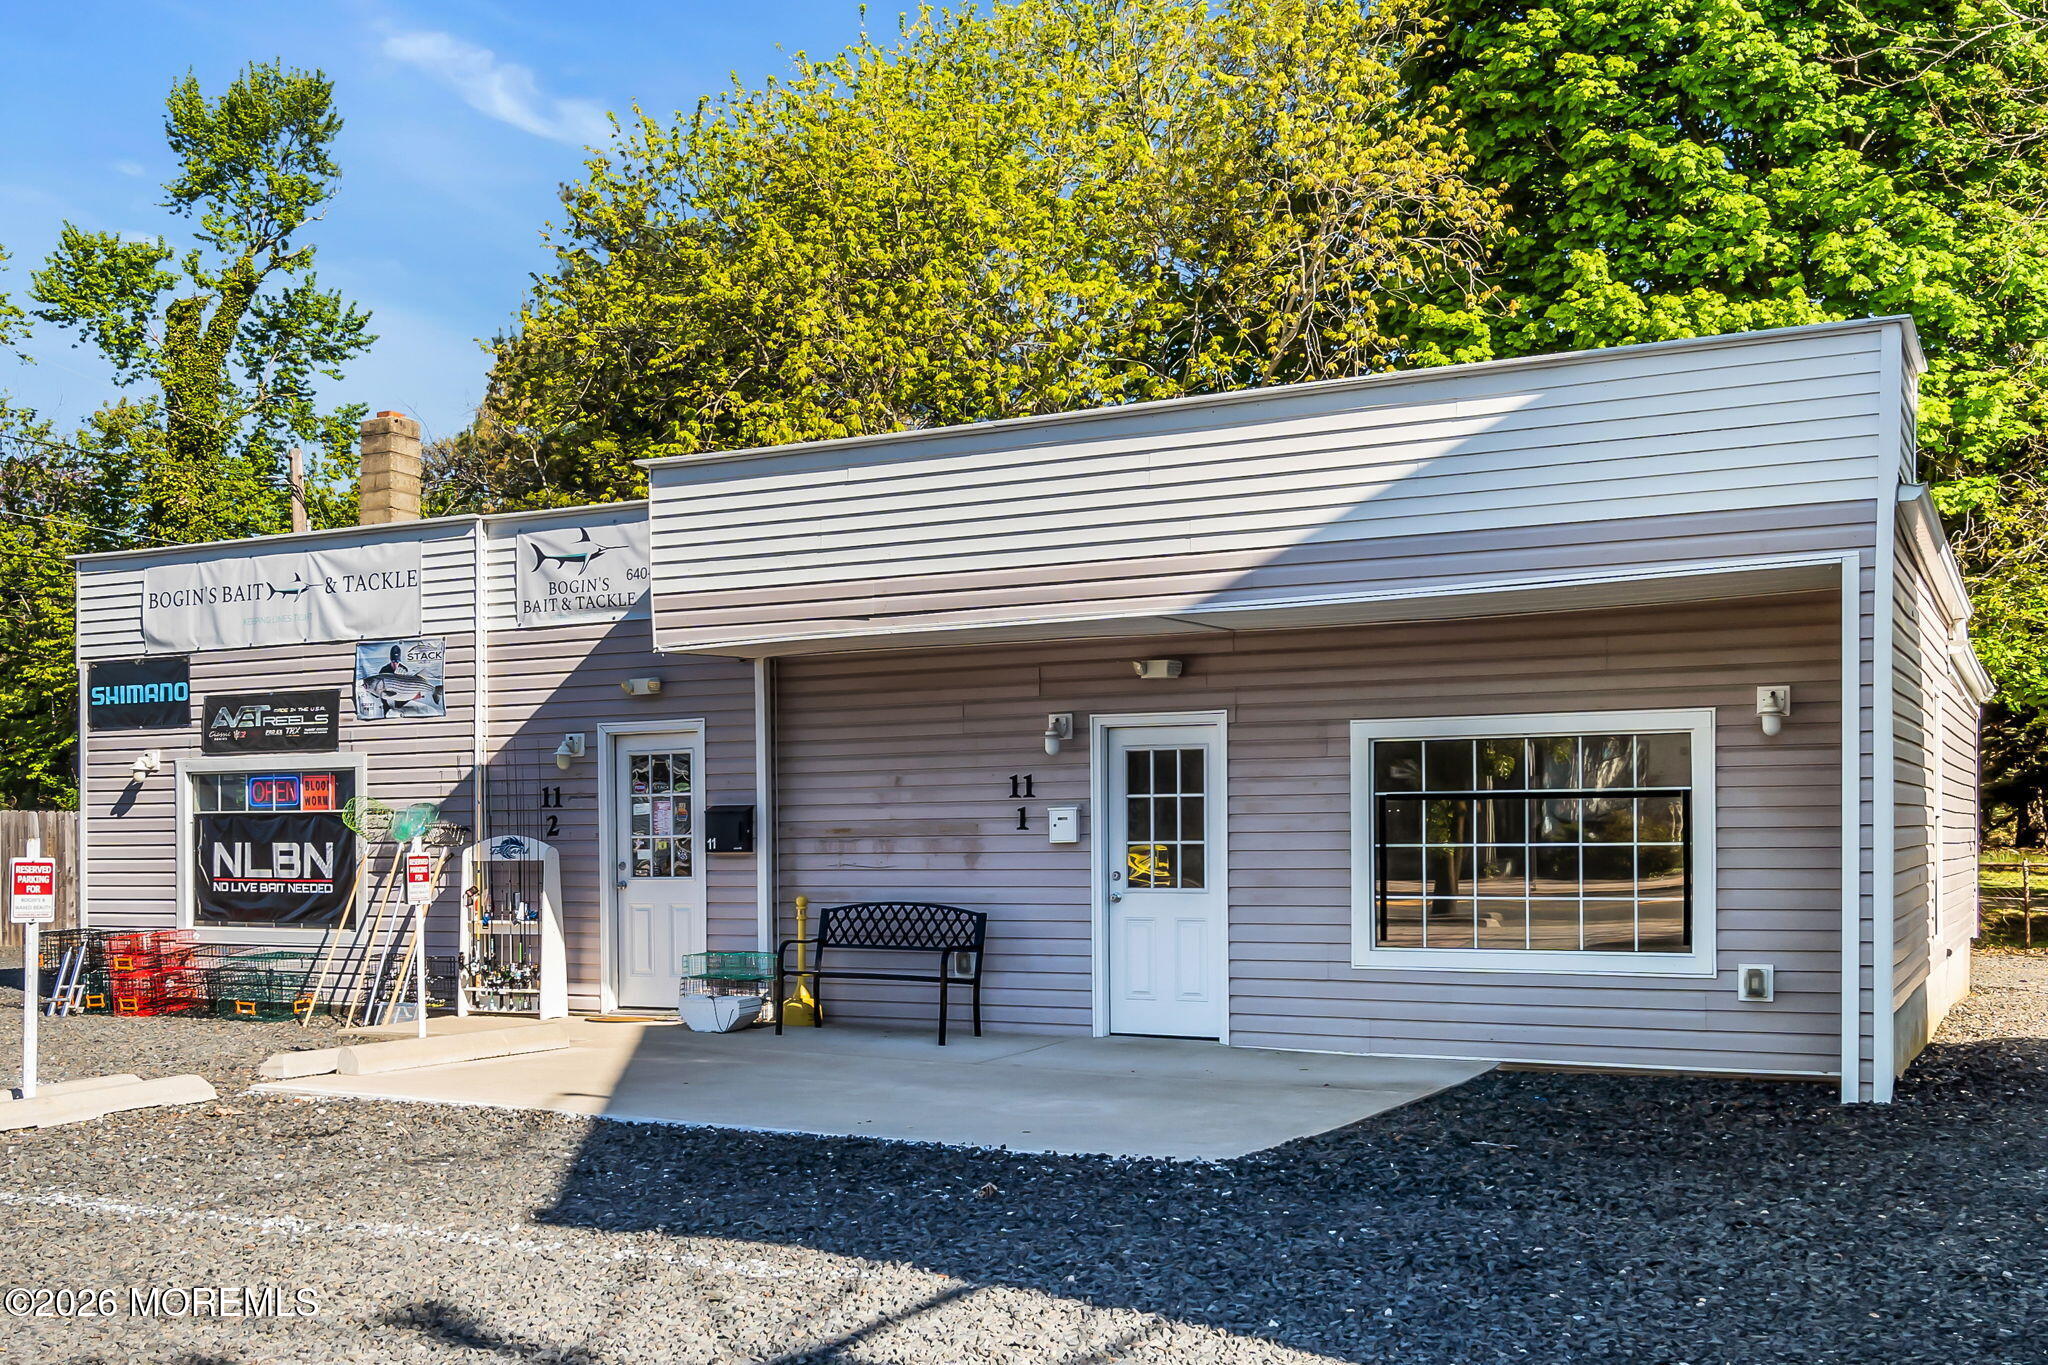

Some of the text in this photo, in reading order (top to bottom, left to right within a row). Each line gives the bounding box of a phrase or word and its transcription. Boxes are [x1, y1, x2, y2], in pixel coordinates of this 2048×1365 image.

[149, 569, 418, 609] BOGIN'S BAIT & TACKLE
[548, 577, 610, 596] BOGIN'S
[523, 592, 637, 614] BAIT & TACKLE
[407, 651, 442, 661] STACK
[91, 681, 189, 706] SHIMANO
[211, 704, 329, 729] AVET REELS
[252, 781, 297, 802] OPEN
[541, 786, 563, 808] 11
[1009, 774, 1036, 798] 11
[546, 815, 560, 837] 2
[1016, 806, 1030, 830] 1
[707, 837, 716, 850] 11
[15, 865, 52, 873] RESERVED
[213, 842, 334, 879] NLBN
[17, 875, 50, 883] PARKING
[26, 885, 41, 893] FOR
[213, 882, 334, 894] NO LIVE BAIT NEEDED
